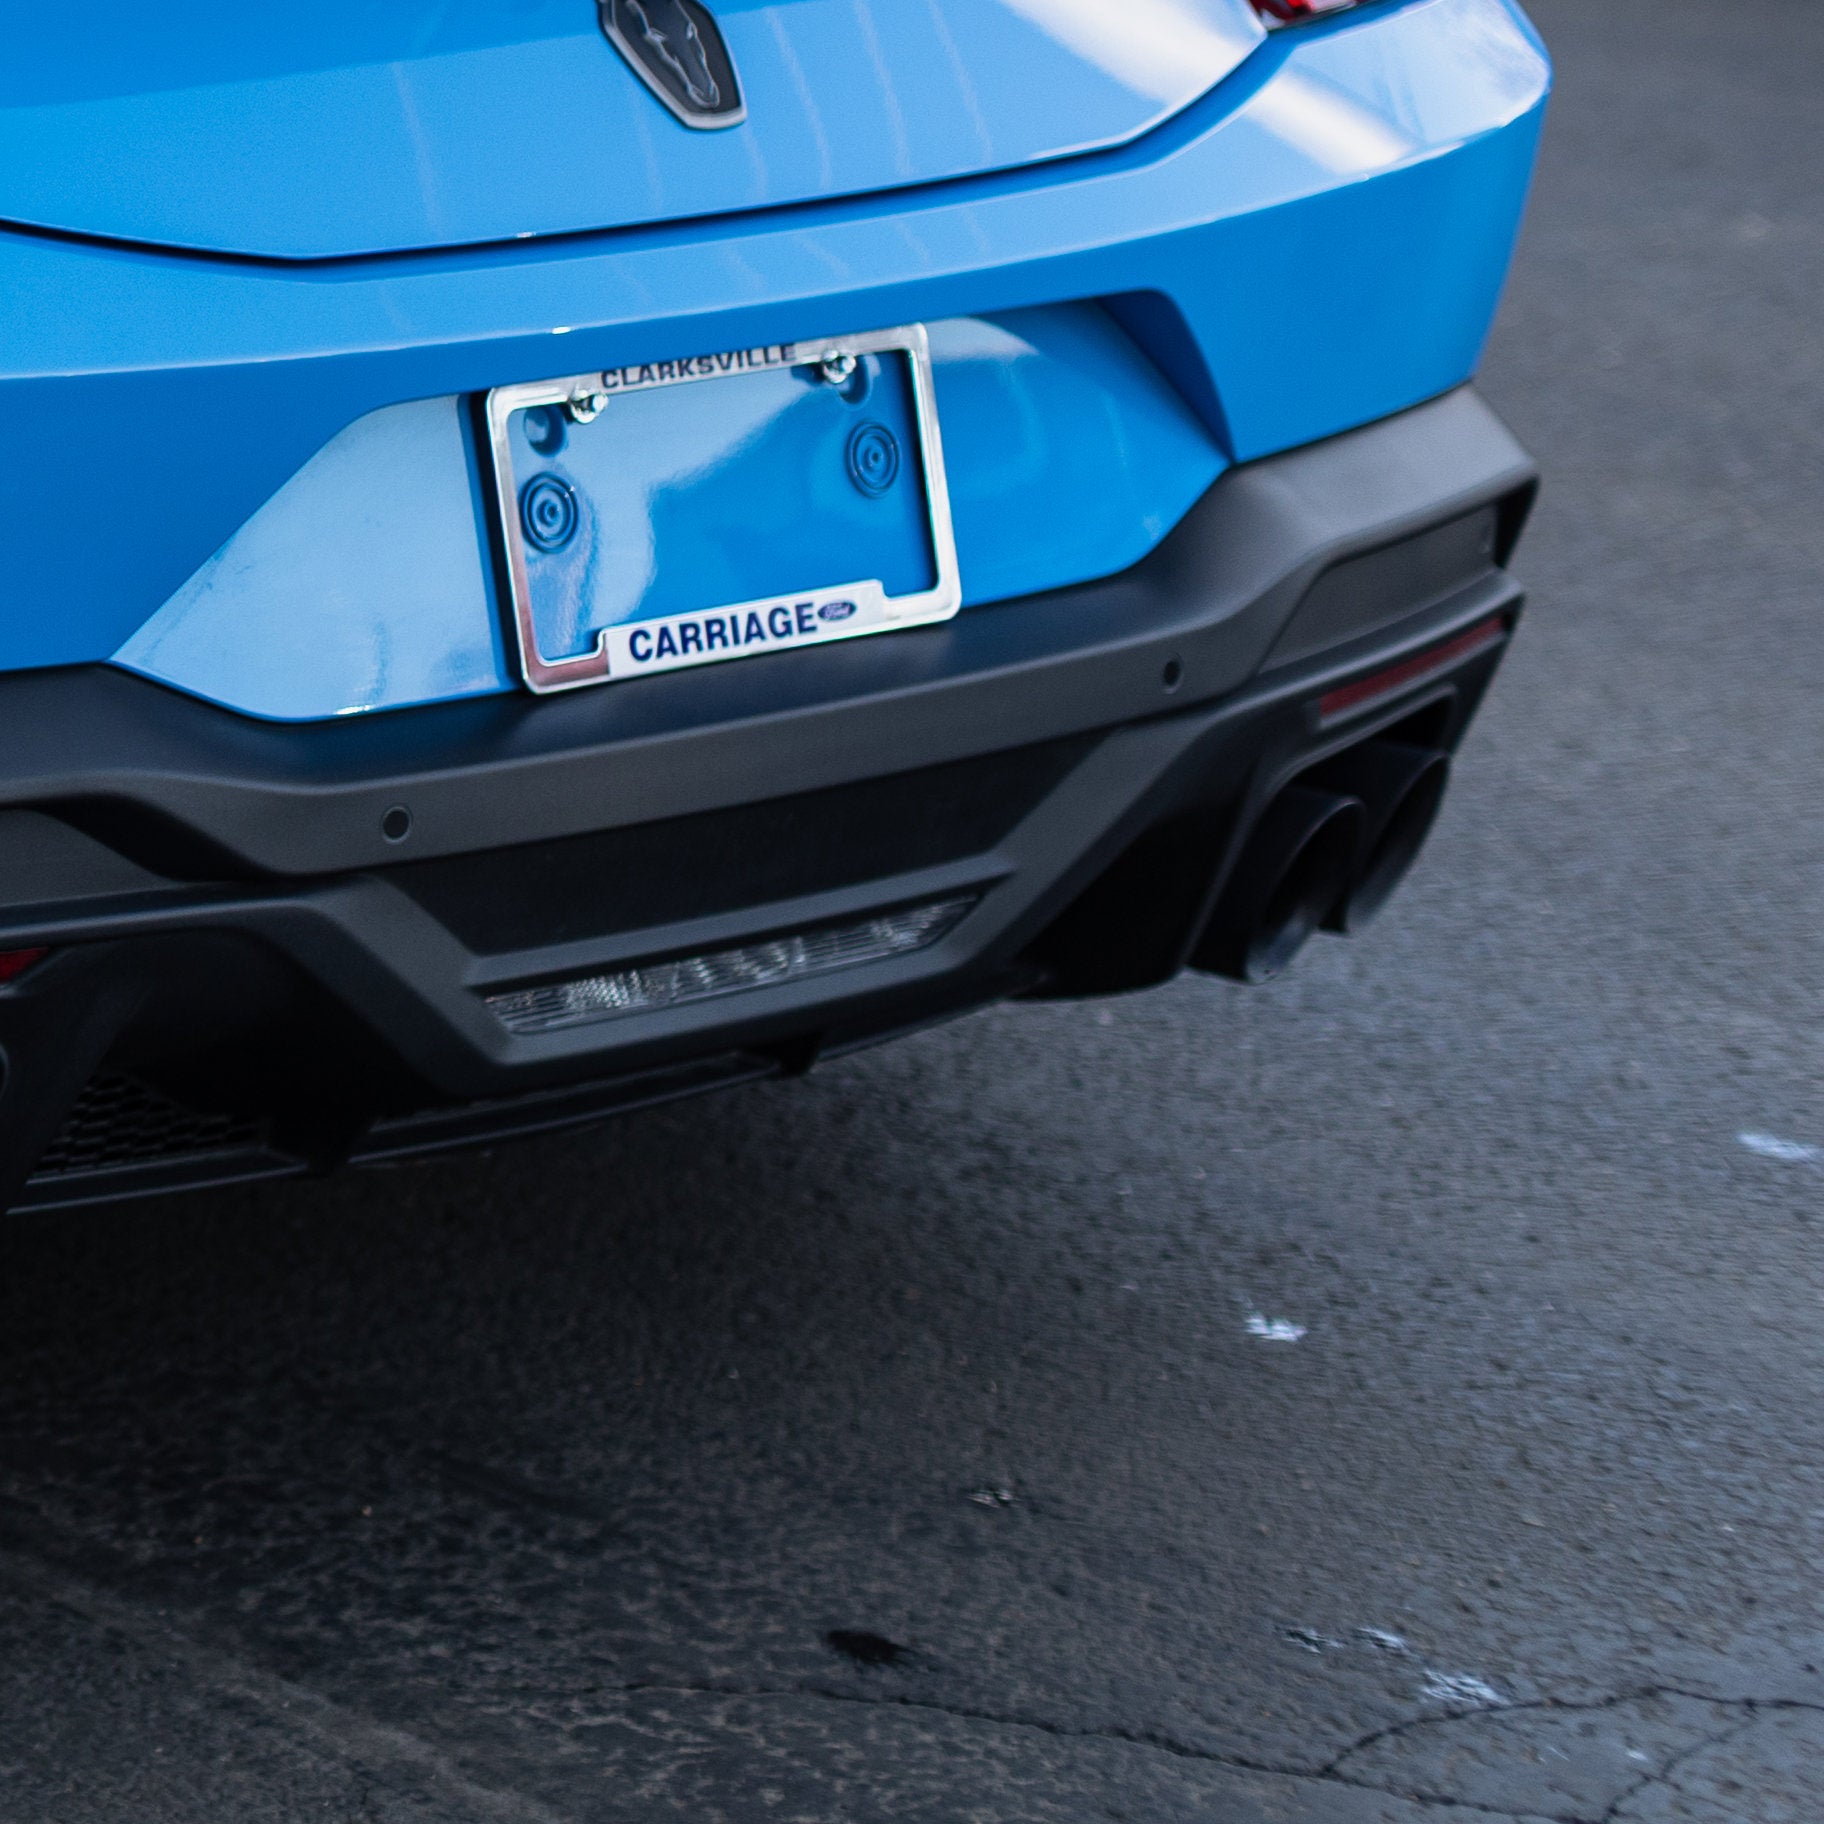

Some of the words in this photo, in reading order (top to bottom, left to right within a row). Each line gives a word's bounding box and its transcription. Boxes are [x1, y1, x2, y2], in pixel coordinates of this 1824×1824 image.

[601, 342, 797, 389] CLARKSVILLE
[628, 602, 818, 662] CARRIAGE
[821, 601, 853, 621] Ford
